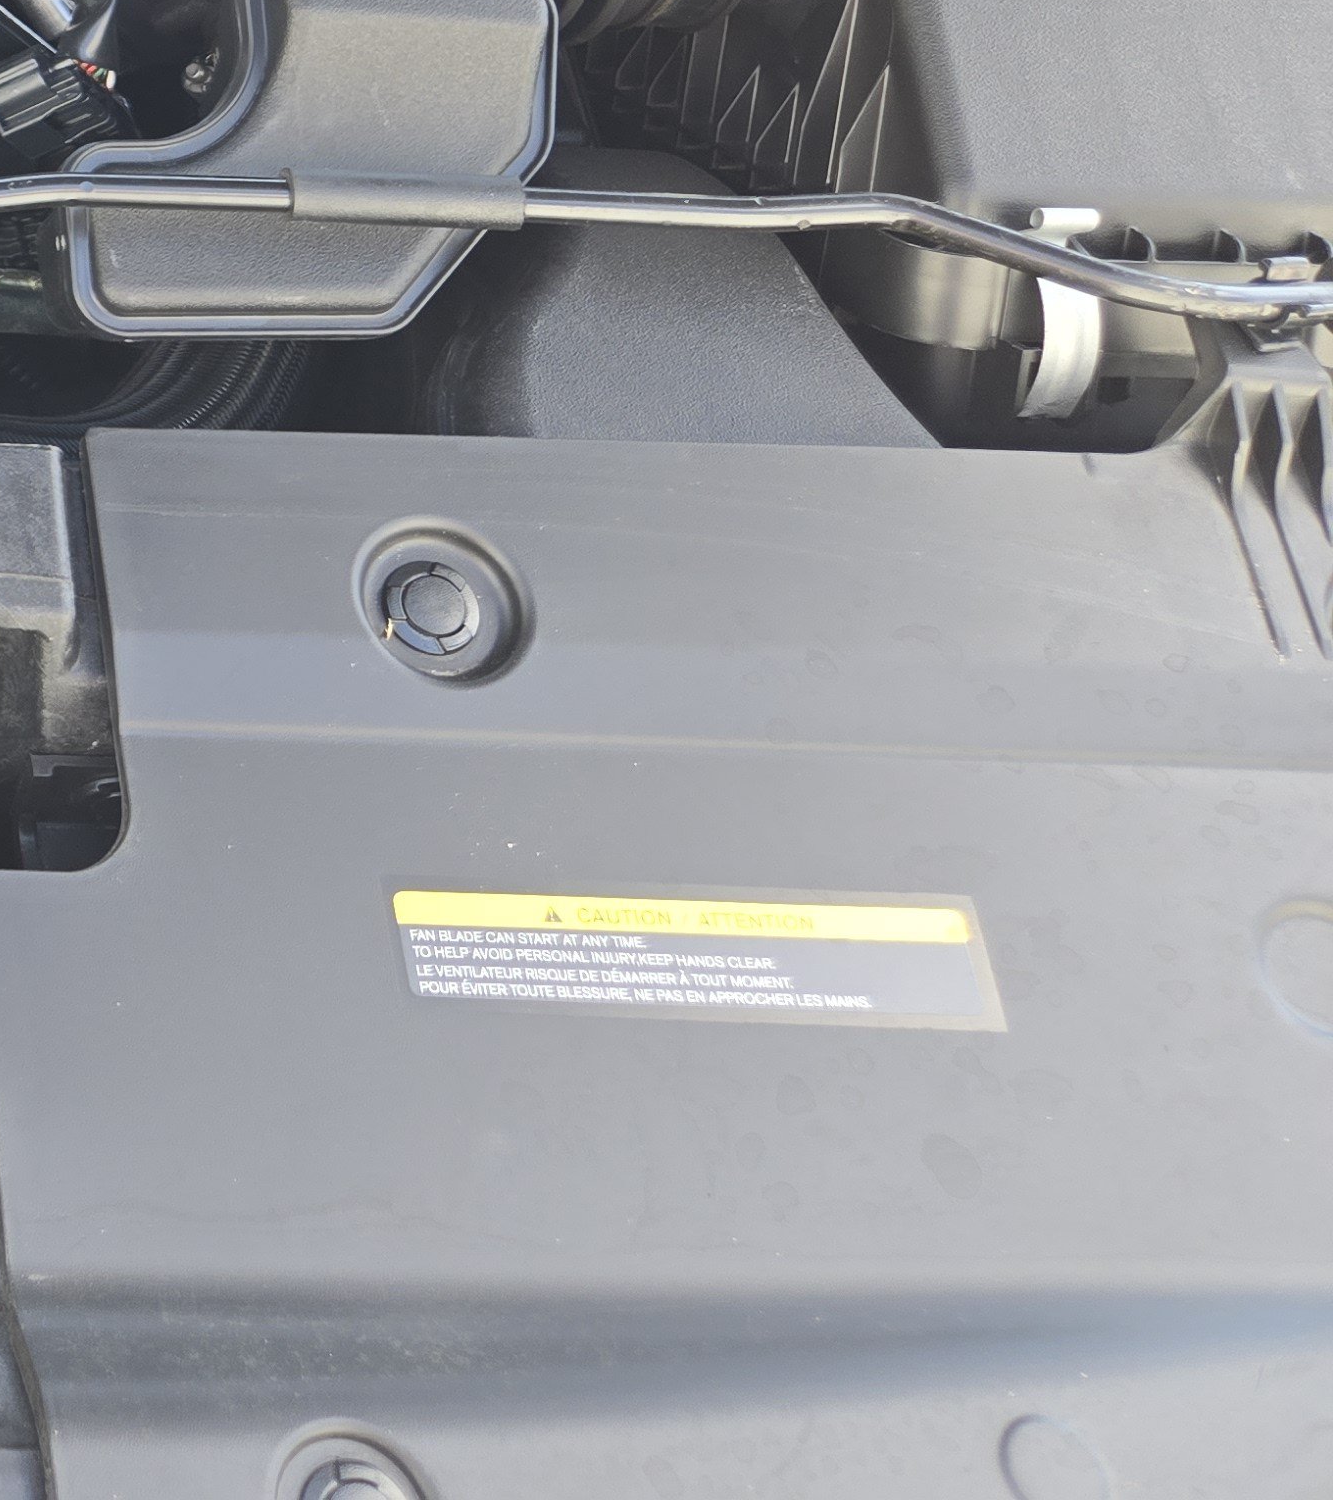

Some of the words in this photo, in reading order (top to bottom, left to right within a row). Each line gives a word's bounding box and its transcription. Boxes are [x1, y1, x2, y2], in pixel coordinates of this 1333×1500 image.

[576, 906, 672, 926] CAUTION
[700, 912, 814, 930] ATTENTION
[409, 929, 436, 941] FAN
[439, 931, 484, 943] BLADE
[485, 932, 515, 944] CAN
[518, 933, 559, 946] START
[562, 935, 579, 946] AT
[582, 935, 608, 948] ANY
[612, 936, 647, 949] TIME.
[412, 946, 432, 958] TO
[434, 946, 470, 959] HELP
[472, 948, 513, 960] AVOID
[515, 950, 590, 963] PERSONAL
[675, 954, 725, 968] HANDS
[727, 956, 777, 970] CLEAR.
[416, 964, 434, 977] LE
[434, 965, 523, 980] VENTILATEUR
[525, 967, 578, 982] RISQUE
[580, 970, 599, 982] DE
[602, 967, 676, 985] DÉMARRER
[679, 969, 691, 985] À
[692, 973, 727, 987] TOUT
[730, 975, 795, 989] MOMENT.
[419, 981, 459, 995] POUR
[461, 979, 508, 996] ÉVITER
[510, 983, 554, 998] TOUTE
[557, 984, 632, 1001] BLESSURE,
[634, 988, 655, 1001] NE
[656, 990, 683, 1003] PAS
[686, 991, 705, 1003] EN
[709, 992, 796, 1006] APPROCHER
[798, 994, 823, 1007] LES
[825, 995, 873, 1008] MAINS.
